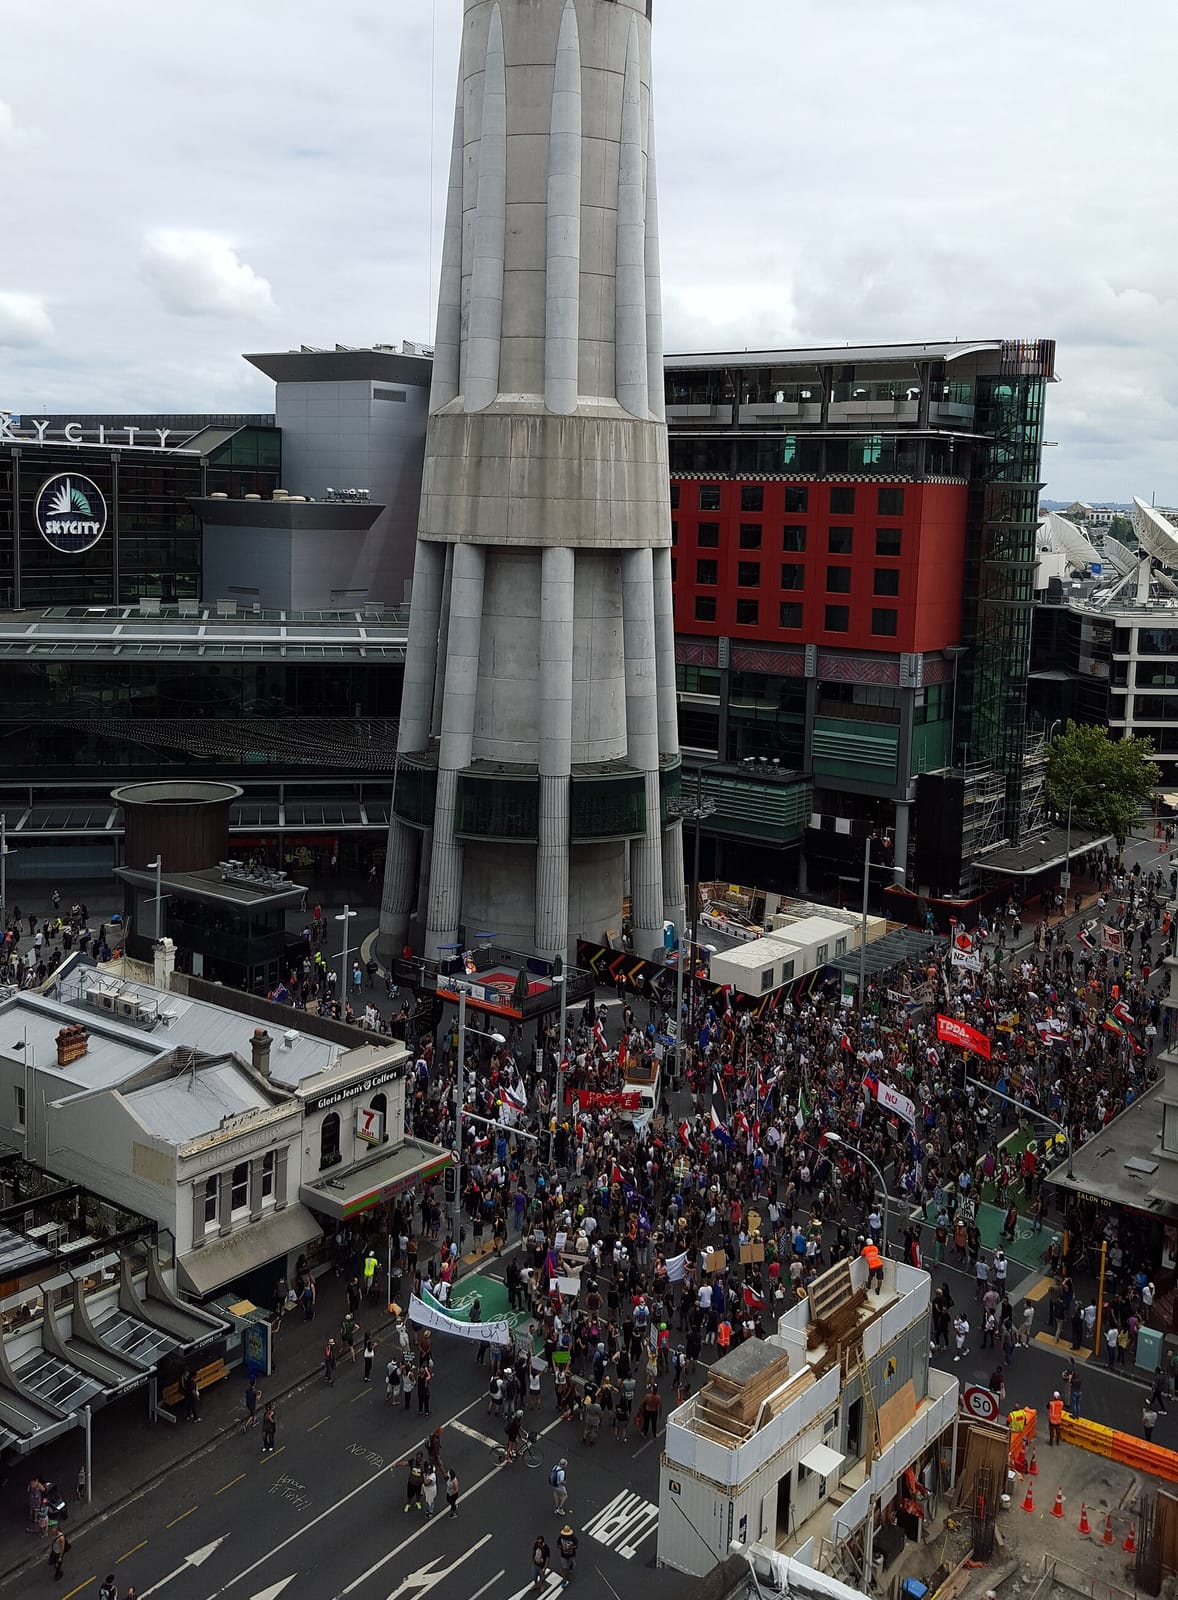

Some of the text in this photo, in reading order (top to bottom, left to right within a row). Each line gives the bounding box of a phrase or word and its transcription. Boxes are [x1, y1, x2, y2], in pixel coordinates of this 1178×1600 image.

[45, 520, 100, 535] SKYCITY
[318, 1071, 397, 1108] Gloria Jean's Coffees
[885, 1091, 898, 1105] NO
[362, 1109, 375, 1130] 7
[1076, 1192, 1112, 1208] SALON 101
[973, 1396, 991, 1413] 50
[345, 1442, 385, 1468] NO TPPA
